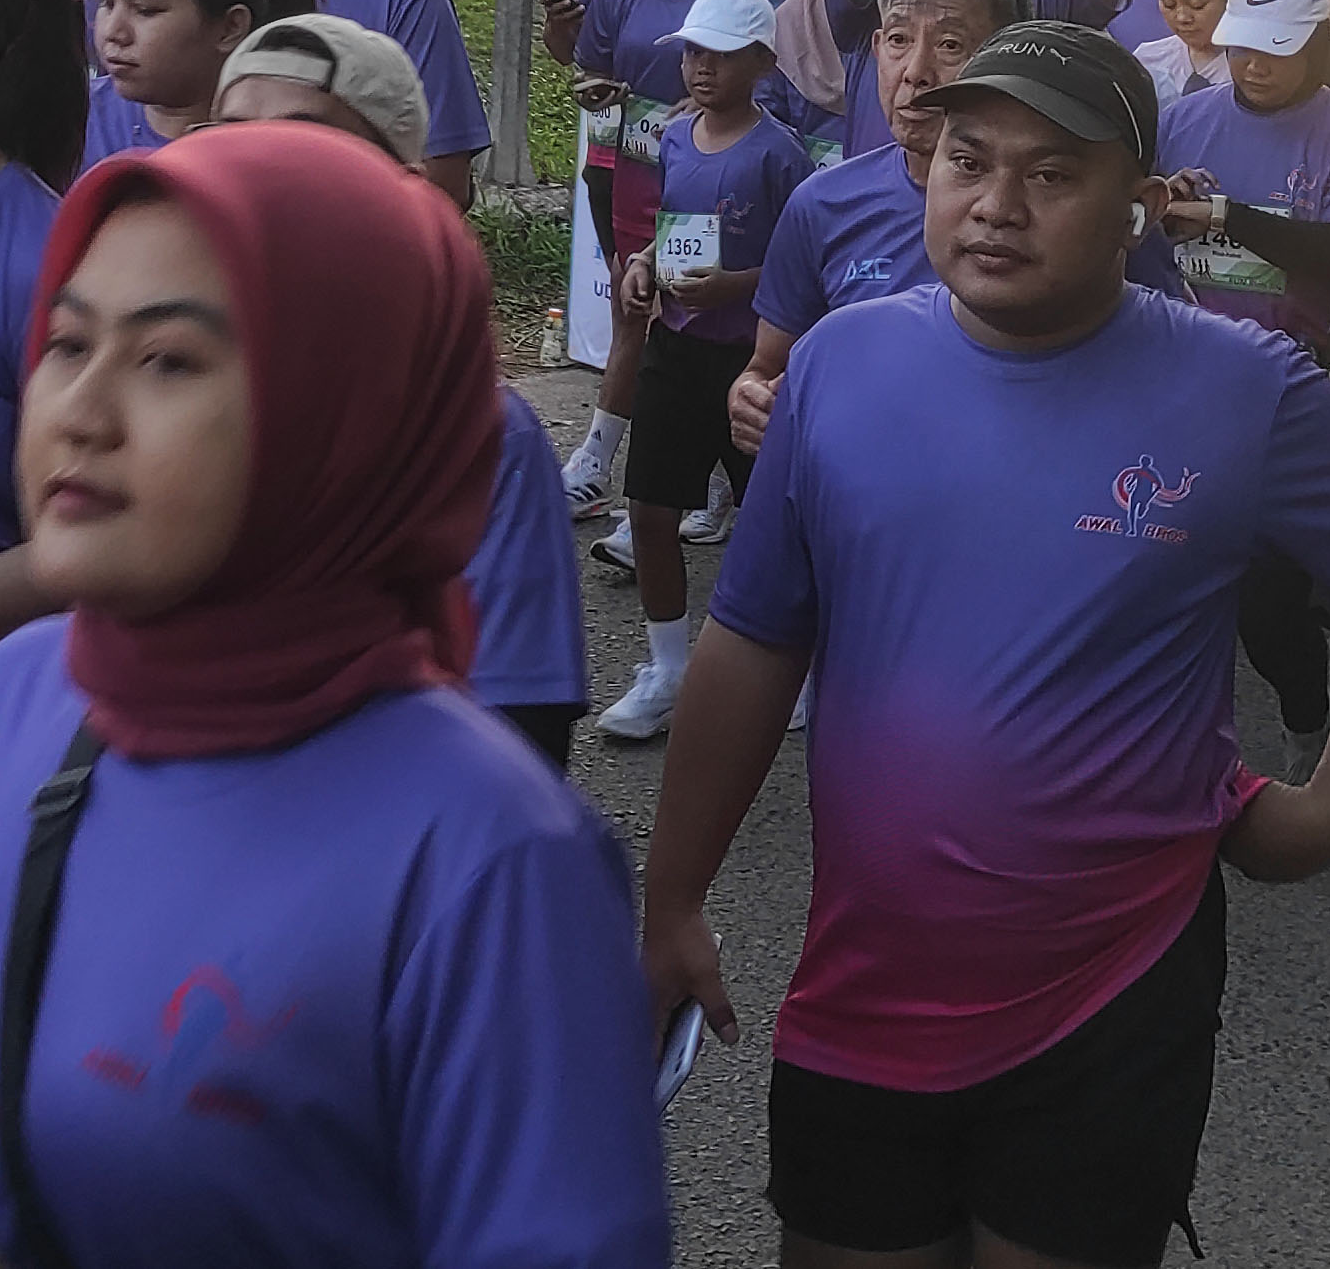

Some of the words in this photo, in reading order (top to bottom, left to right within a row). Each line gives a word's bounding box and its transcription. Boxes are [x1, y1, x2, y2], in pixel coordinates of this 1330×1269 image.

[997, 42, 1046, 57] RUN
[667, 237, 703, 256] 1362
[1074, 514, 1124, 535] AWAL
[1141, 523, 1189, 544] BROS
